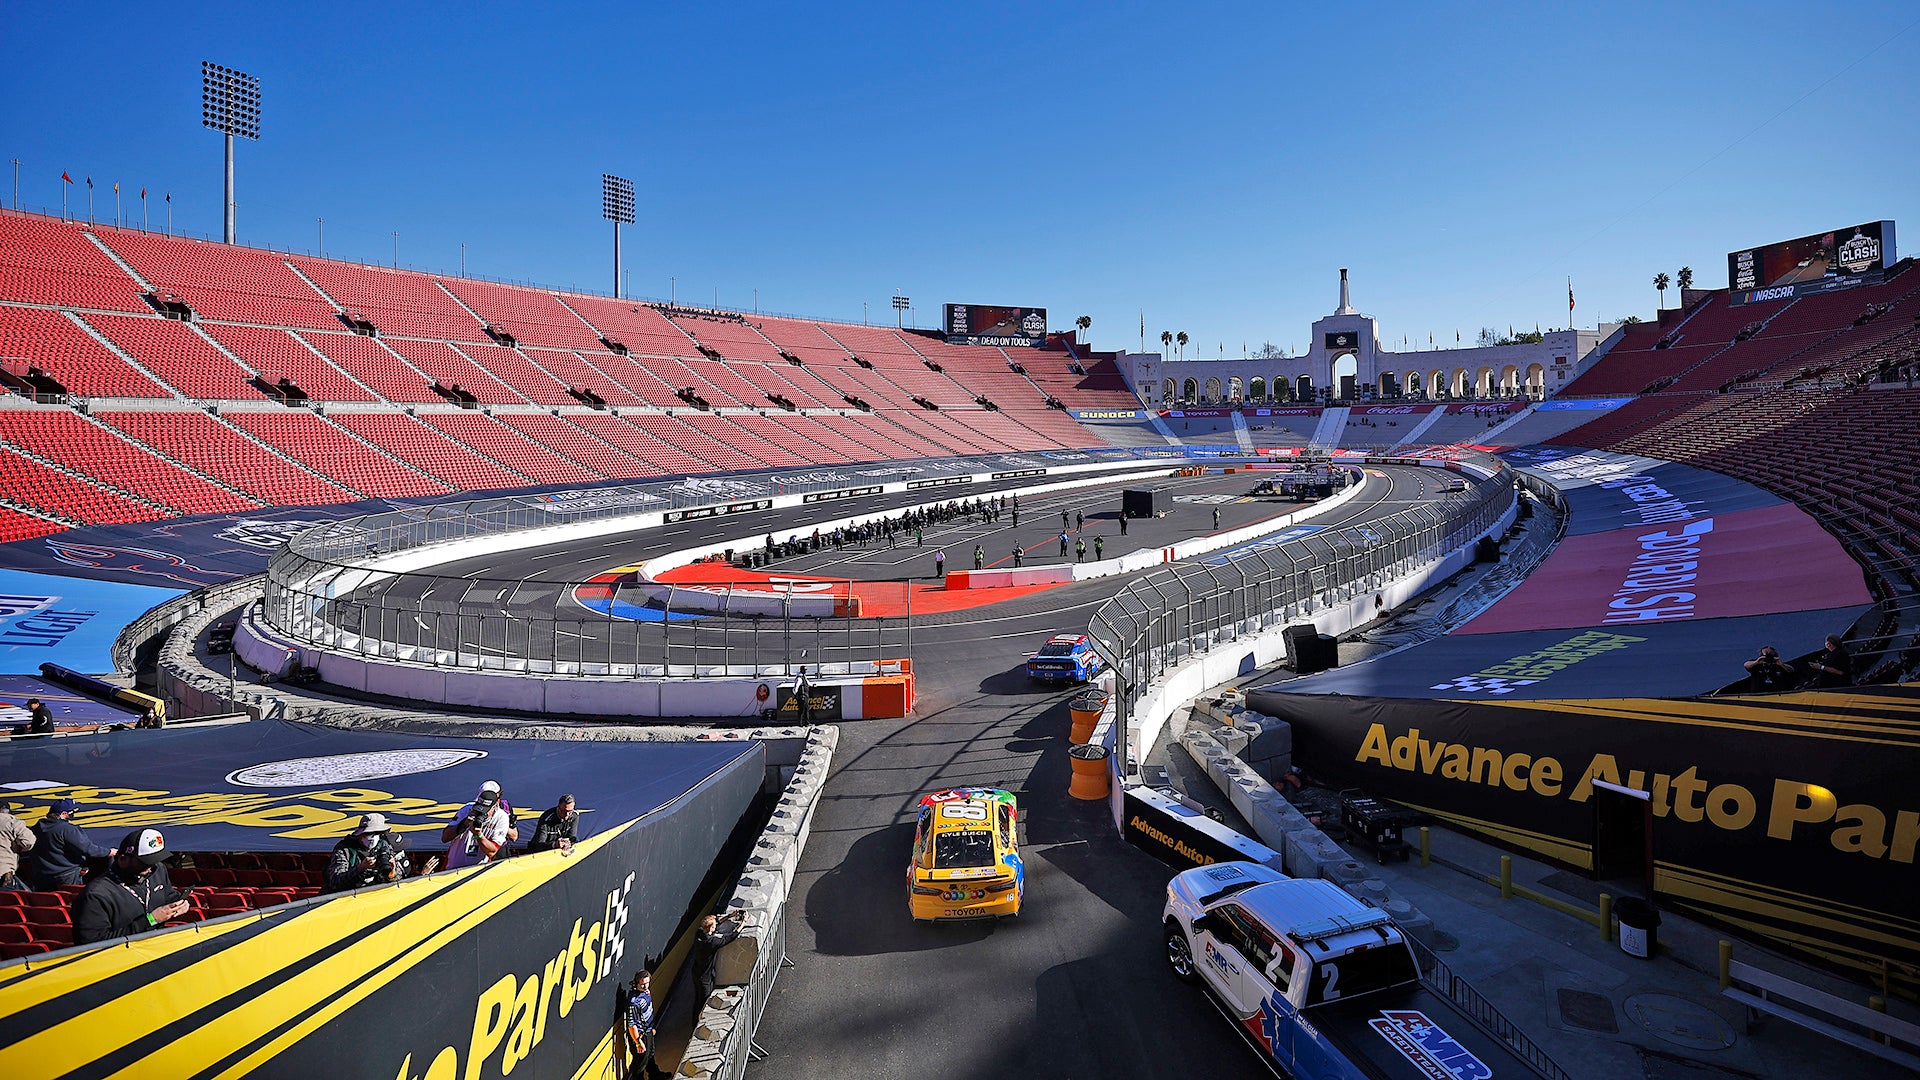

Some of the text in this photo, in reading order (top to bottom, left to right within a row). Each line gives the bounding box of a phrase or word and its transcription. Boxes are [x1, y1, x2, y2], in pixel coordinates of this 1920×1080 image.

[1841, 245, 1877, 262] CLASH
[1755, 285, 1795, 302] NASCAR
[1023, 321, 1045, 330] CLASH
[981, 336, 1031, 347] DEAD ON TOOLS
[1079, 411, 1136, 419] SUNOCO
[1366, 405, 1416, 414] Coca-Cola
[1355, 723, 1563, 797] Advance
[1569, 753, 1920, 863] Auto Par
[1131, 815, 1174, 849] Advance
[1174, 840, 1204, 866] Auto
[1006, 893, 1014, 902] 18
[952, 907, 986, 916] TOYOTA
[1265, 942, 1283, 983] 2
[1321, 963, 1341, 1001] 2
[465, 917, 601, 1080] Parts
[1382, 1026, 1446, 1080] SAFETY TEAM
